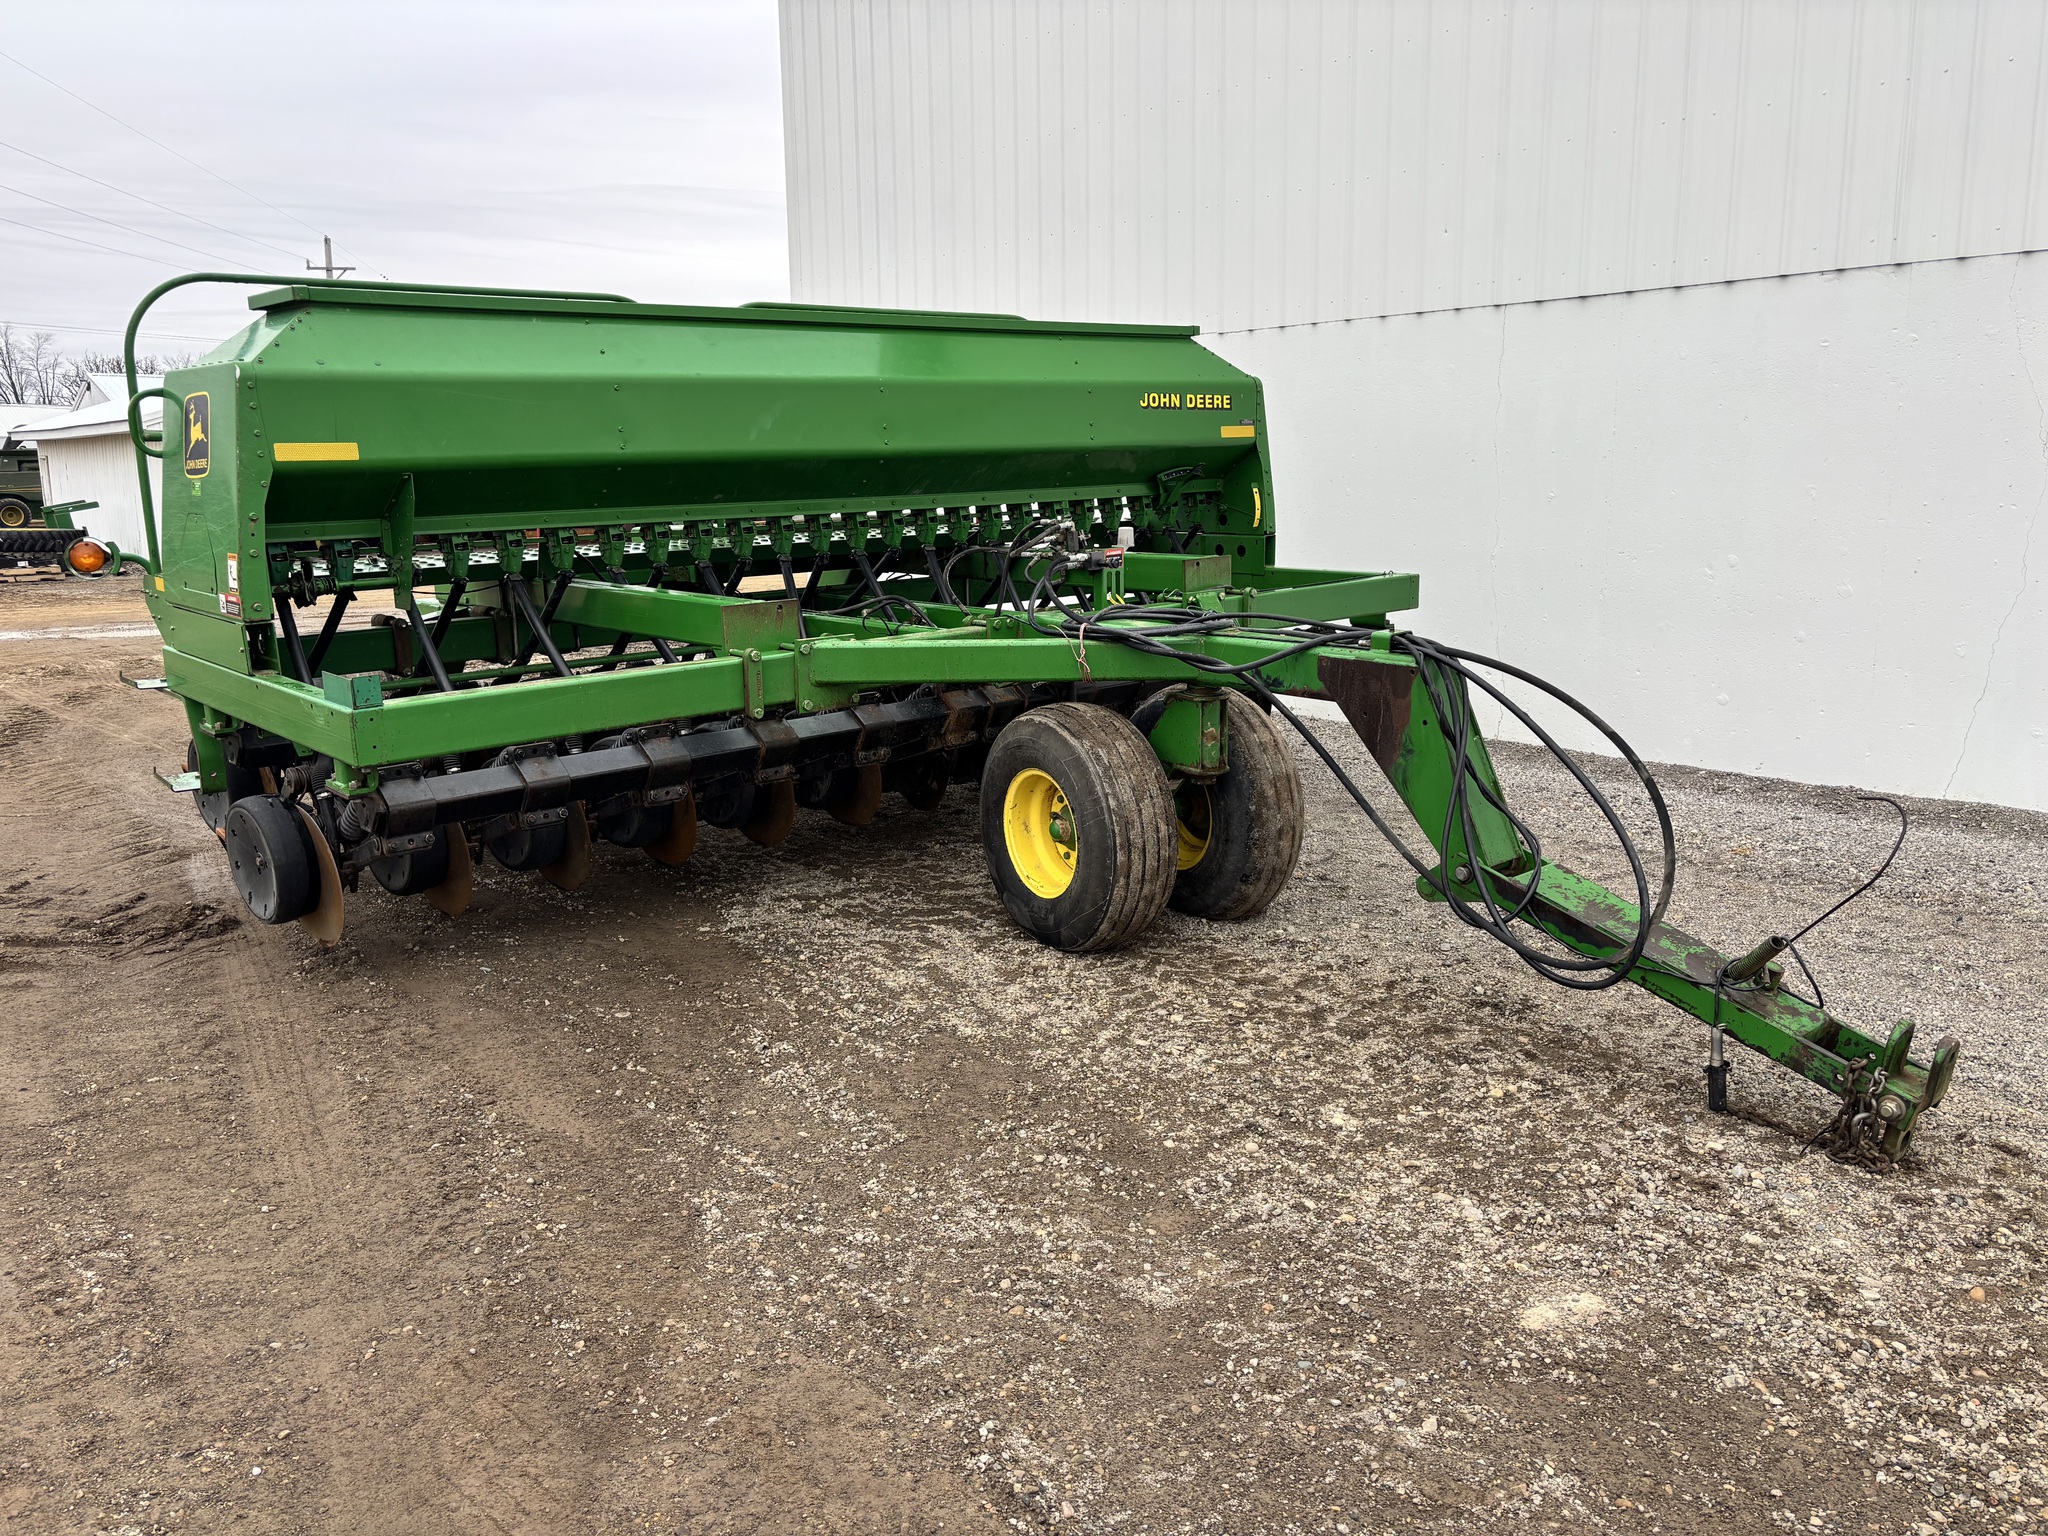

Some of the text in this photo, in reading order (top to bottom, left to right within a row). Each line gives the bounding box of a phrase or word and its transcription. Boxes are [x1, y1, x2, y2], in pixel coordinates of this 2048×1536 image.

[1139, 392, 1232, 411] JOHN DEERE
[185, 459, 207, 469] JOHN DEERE
